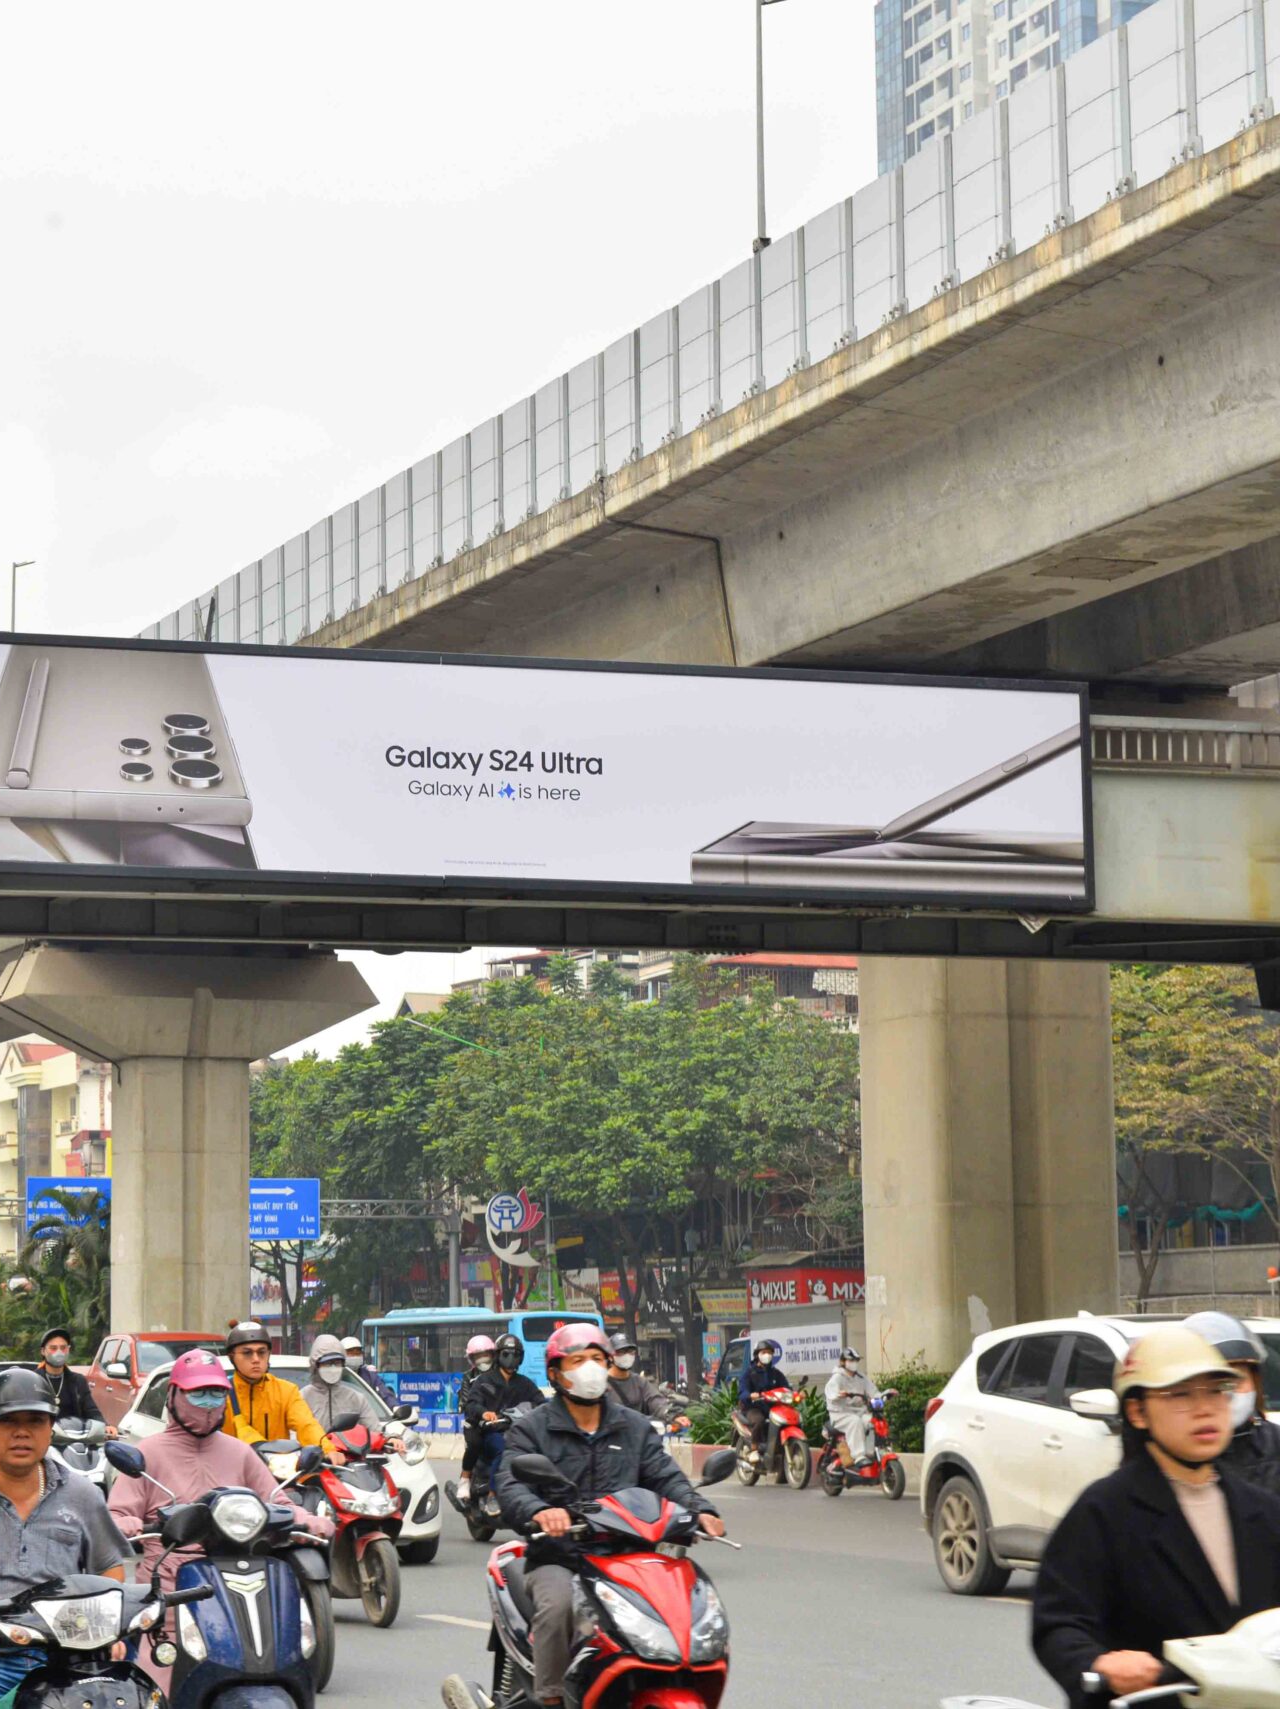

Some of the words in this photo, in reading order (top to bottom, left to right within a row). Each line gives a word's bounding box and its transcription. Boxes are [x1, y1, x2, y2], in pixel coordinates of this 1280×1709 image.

[385, 745, 484, 777] Galaxy
[489, 749, 535, 773] S24
[541, 751, 603, 776] Ultra
[408, 779, 474, 802] Galaxy
[478, 783, 494, 798] AI
[518, 784, 532, 799] is
[538, 785, 581, 801] here
[761, 1280, 796, 1301] MIXUE
[832, 1281, 865, 1299] MIX
